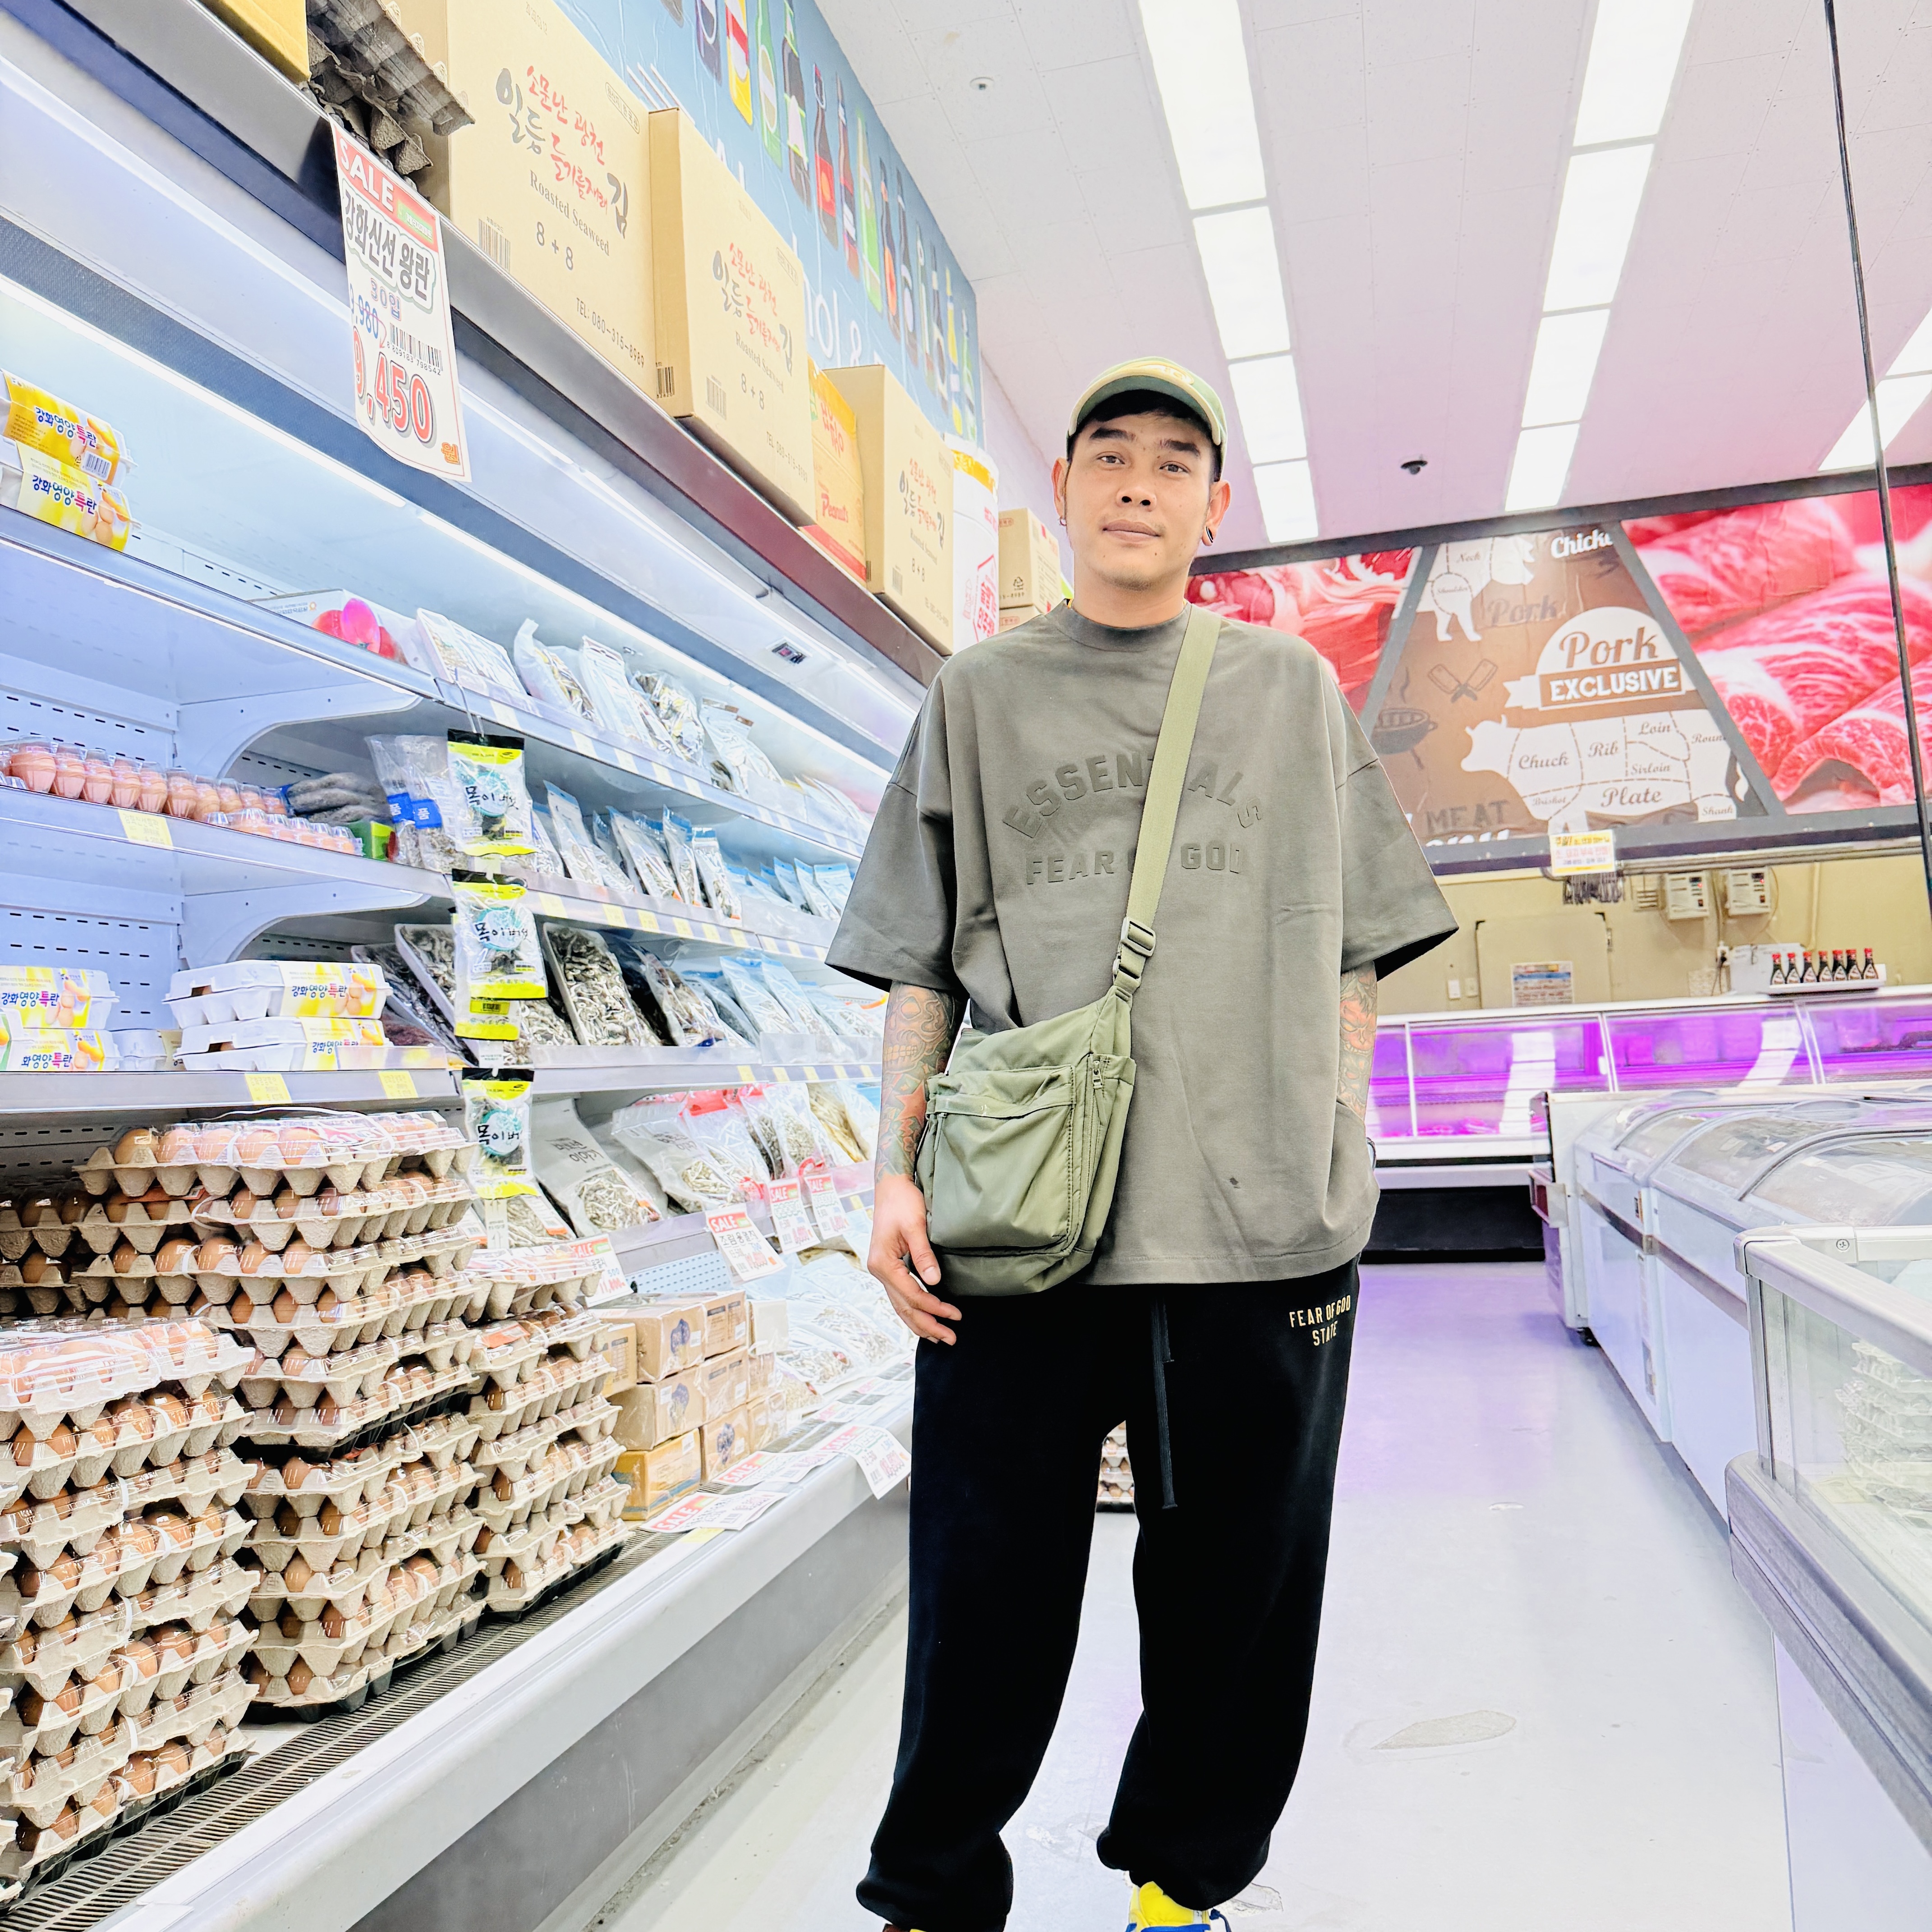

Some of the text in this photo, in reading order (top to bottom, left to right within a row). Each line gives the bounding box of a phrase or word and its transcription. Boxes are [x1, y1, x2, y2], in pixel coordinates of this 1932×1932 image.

[340, 138, 394, 212] SALE
[529, 170, 610, 256] Roasted Seaweed
[536, 221, 545, 246] 8
[566, 246, 574, 271] 8
[399, 243, 430, 301] 왕란
[370, 278, 401, 321] 30입
[576, 298, 644, 368] TEL: 080-315-8989
[416, 359, 441, 376] 798542
[353, 326, 433, 443] 9,450
[741, 373, 747, 393] 8
[759, 390, 764, 410] 8
[35, 407, 97, 448] 강화영양특란
[32, 474, 97, 515] 강화영양특란
[1456, 552, 1481, 563] Neck
[1488, 594, 1557, 627] Pork
[1559, 625, 1659, 669] Pork
[1550, 666, 1679, 703] EXCLUSIVE
[1638, 721, 1671, 736] Loin
[1518, 751, 1570, 770] Chuck
[1587, 740, 1619, 758] Rib
[1630, 762, 1671, 775] Sirloin
[1002, 754, 1263, 839] ESSENALS
[1601, 786, 1662, 808] Plate
[1426, 799, 1509, 834] MEAT
[1026, 850, 1115, 885] FEAR
[1, 991, 60, 1006] 강화영양특란
[291, 983, 348, 998] 강화영양특란
[21, 1052, 73, 1069] 화영양특란
[478, 1124, 520, 1145] 목이버
[769, 1187, 788, 1202] SALE
[711, 1215, 738, 1232] SALE
[1289, 1294, 1351, 1328] FEAR OF GOD
[723, 1464, 759, 1482] SALE
[656, 1507, 700, 1530] SALE
